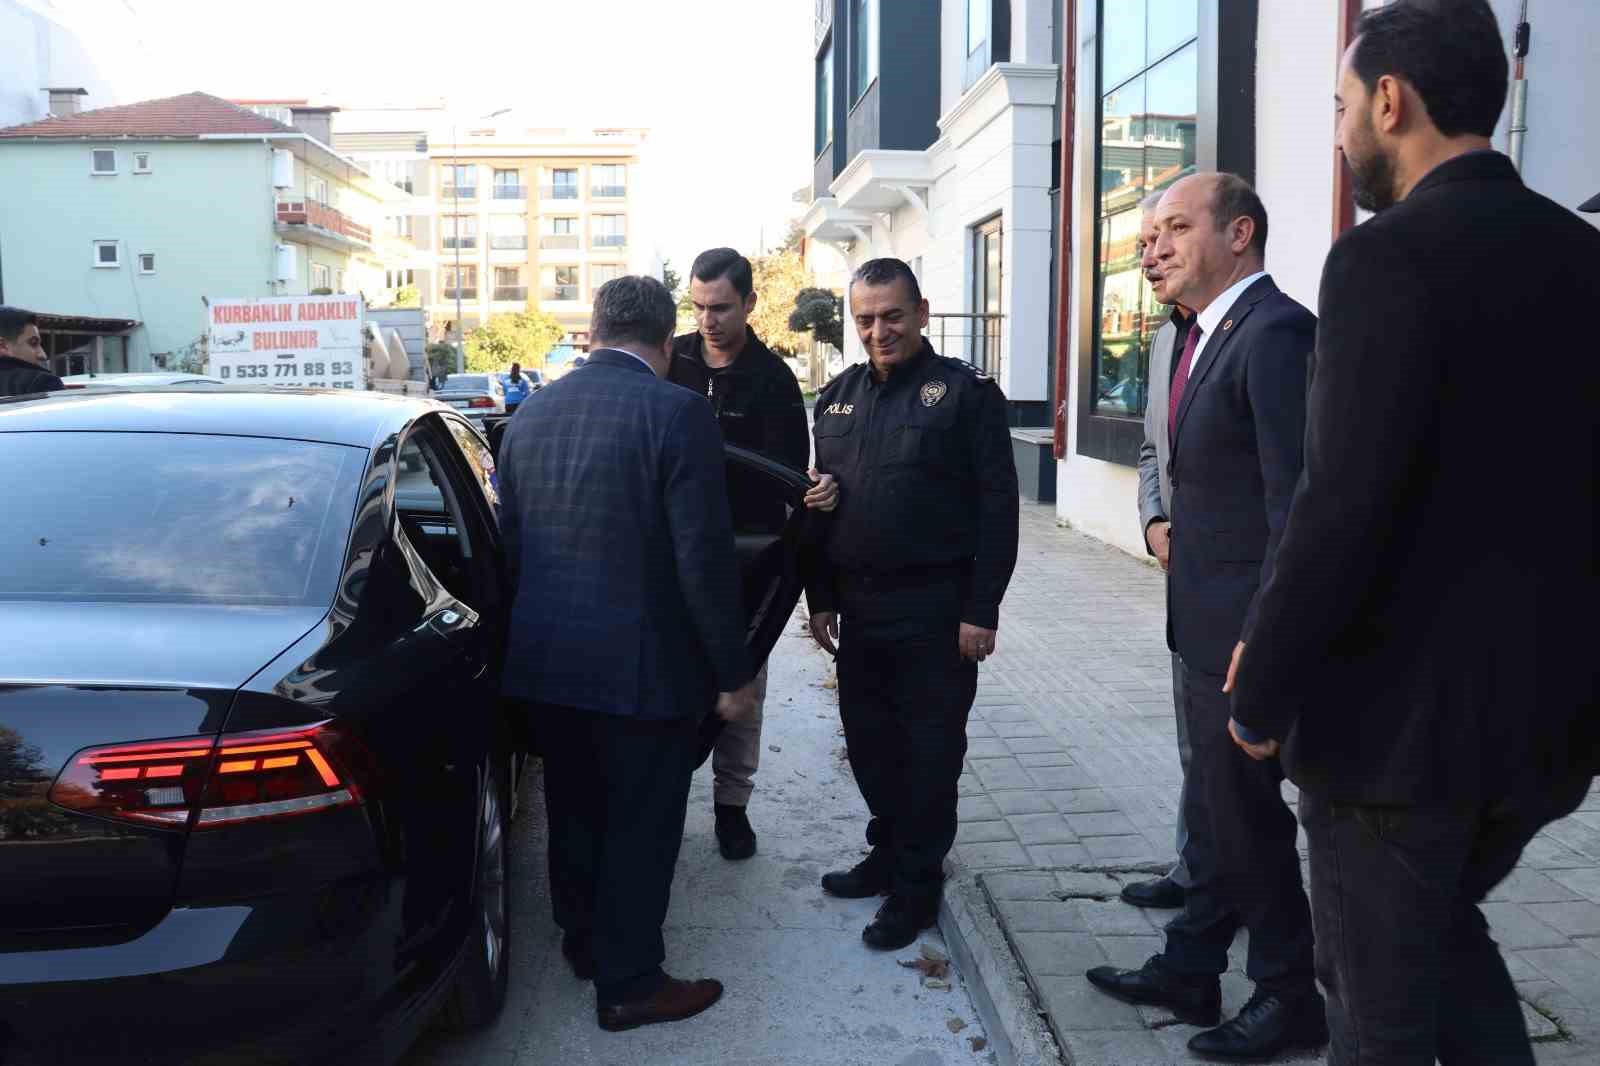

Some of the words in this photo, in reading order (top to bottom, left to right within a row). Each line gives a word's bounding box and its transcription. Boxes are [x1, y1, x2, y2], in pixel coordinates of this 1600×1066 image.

[213, 304, 292, 323] KURBANLIK
[298, 301, 357, 321] ADAKLIK
[252, 330, 319, 351] BULUNUR
[220, 365, 231, 379] 0
[236, 364, 268, 378] 533
[274, 363, 298, 377] 771
[303, 362, 325, 376] 88
[331, 361, 352, 376] 93
